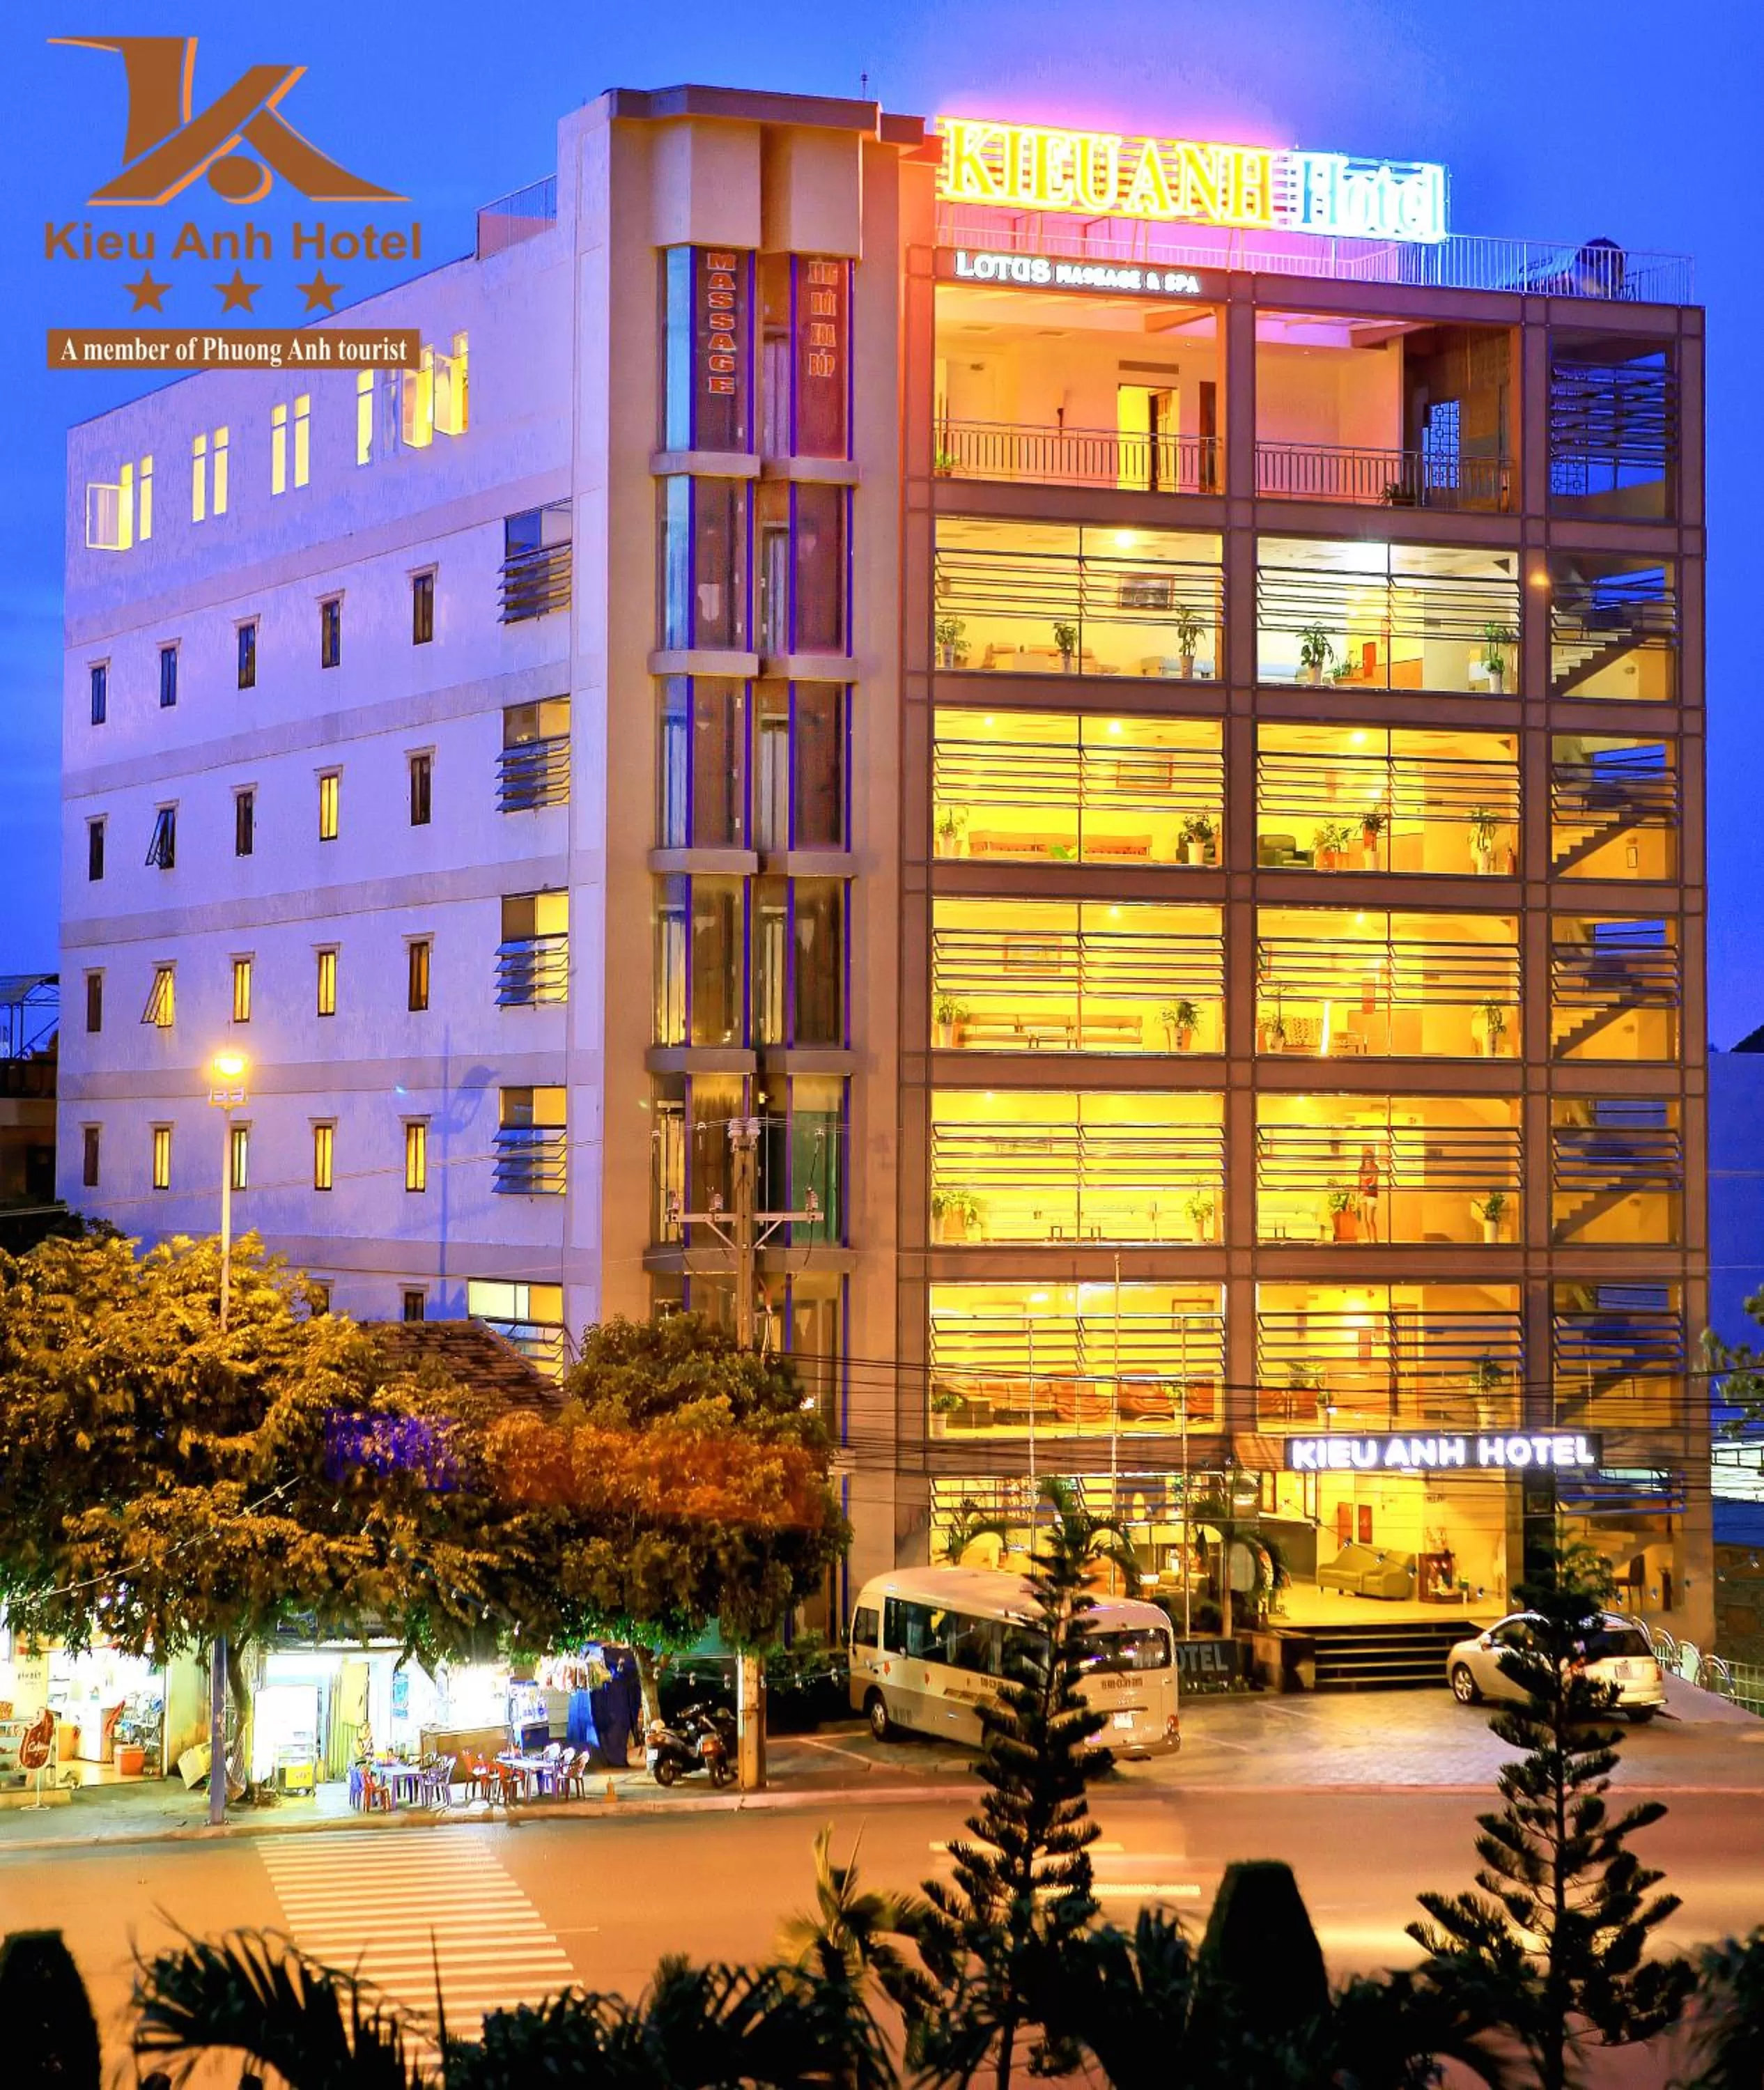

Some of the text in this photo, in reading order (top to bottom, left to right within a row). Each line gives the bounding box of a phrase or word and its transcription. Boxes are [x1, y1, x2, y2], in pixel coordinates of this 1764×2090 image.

[943, 118, 1123, 213] KIEU
[1124, 137, 1279, 228] ANH
[1164, 272, 1200, 293] SPA
[706, 251, 736, 395] MASSAGE
[1292, 1435, 1595, 1469] KIEU ANH HOTEL
